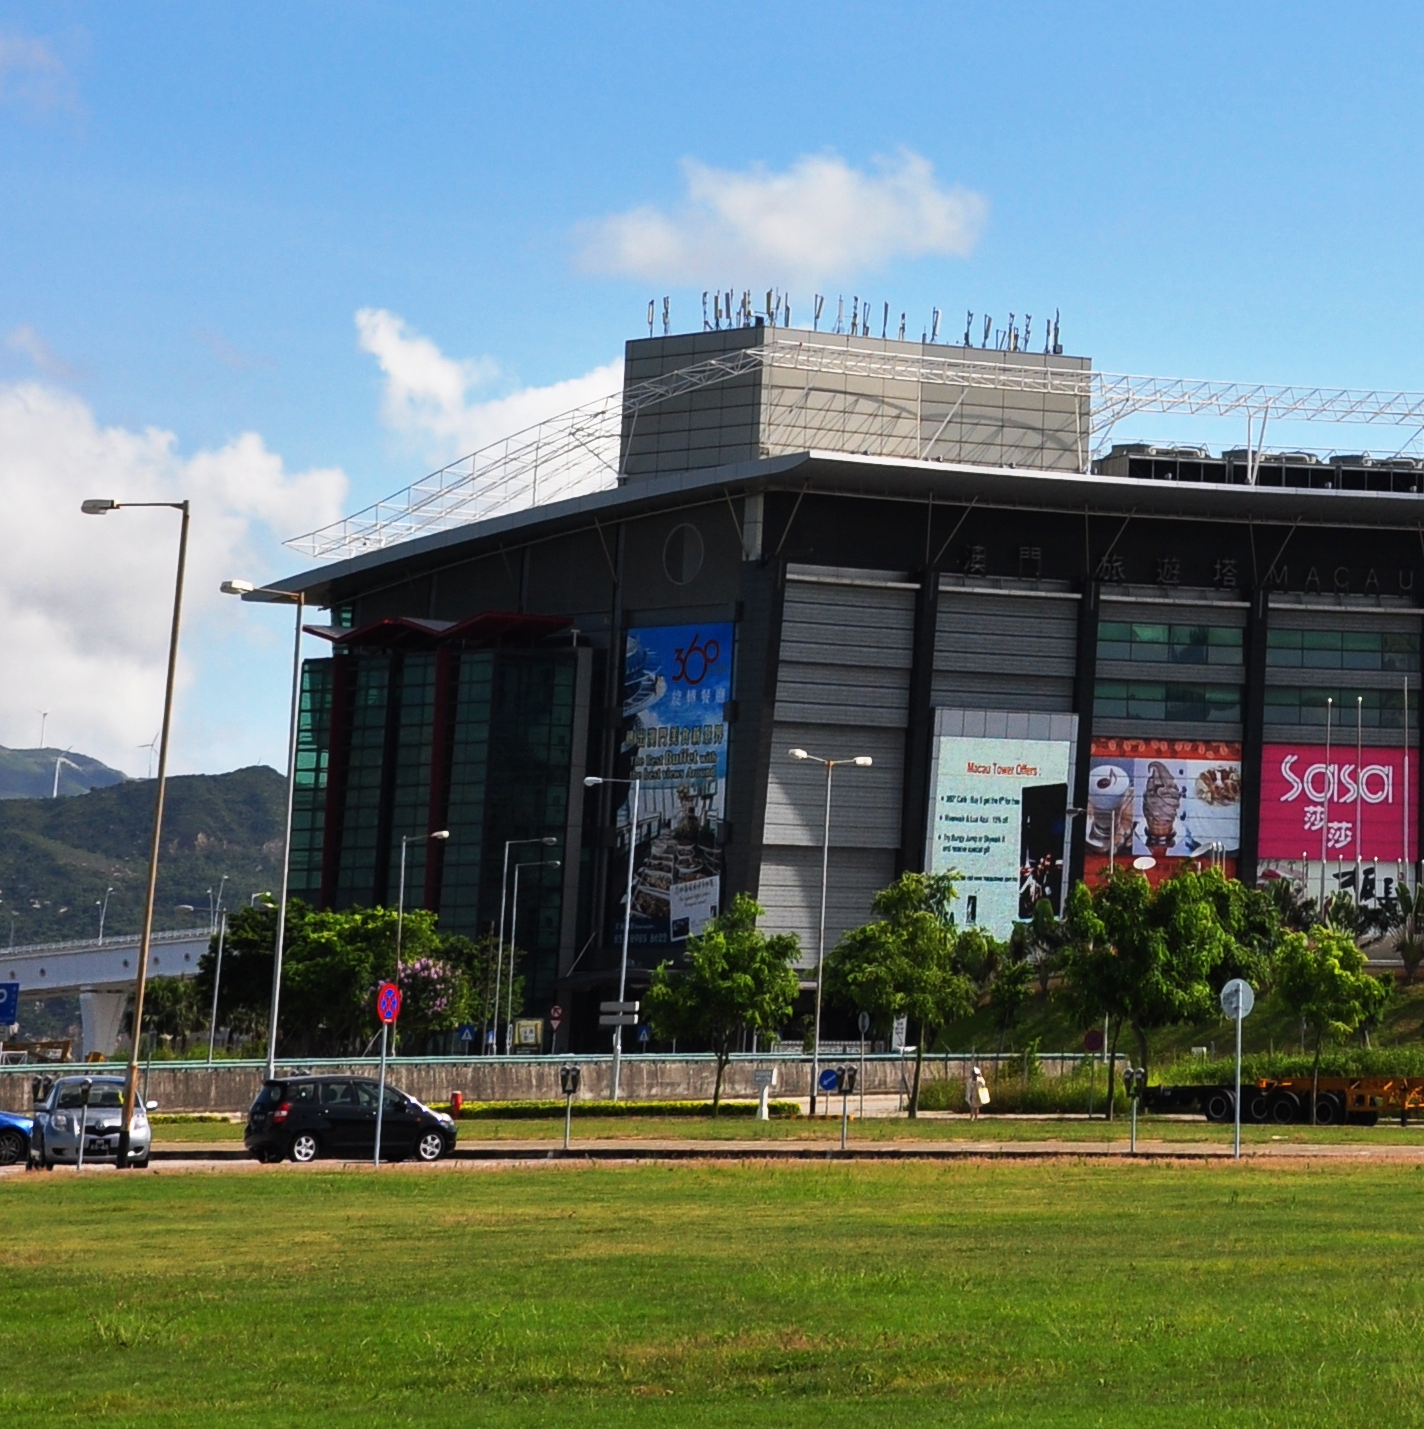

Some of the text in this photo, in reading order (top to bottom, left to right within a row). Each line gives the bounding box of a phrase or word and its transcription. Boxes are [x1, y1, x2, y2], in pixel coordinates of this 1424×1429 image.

[963, 545, 1238, 587] 澳門旅遊塔
[1266, 566, 1414, 590] MACAU
[664, 749, 698, 765] Buffet
[967, 762, 991, 775] Macau
[993, 763, 1014, 775] Tower
[1015, 764, 1037, 776] Offers
